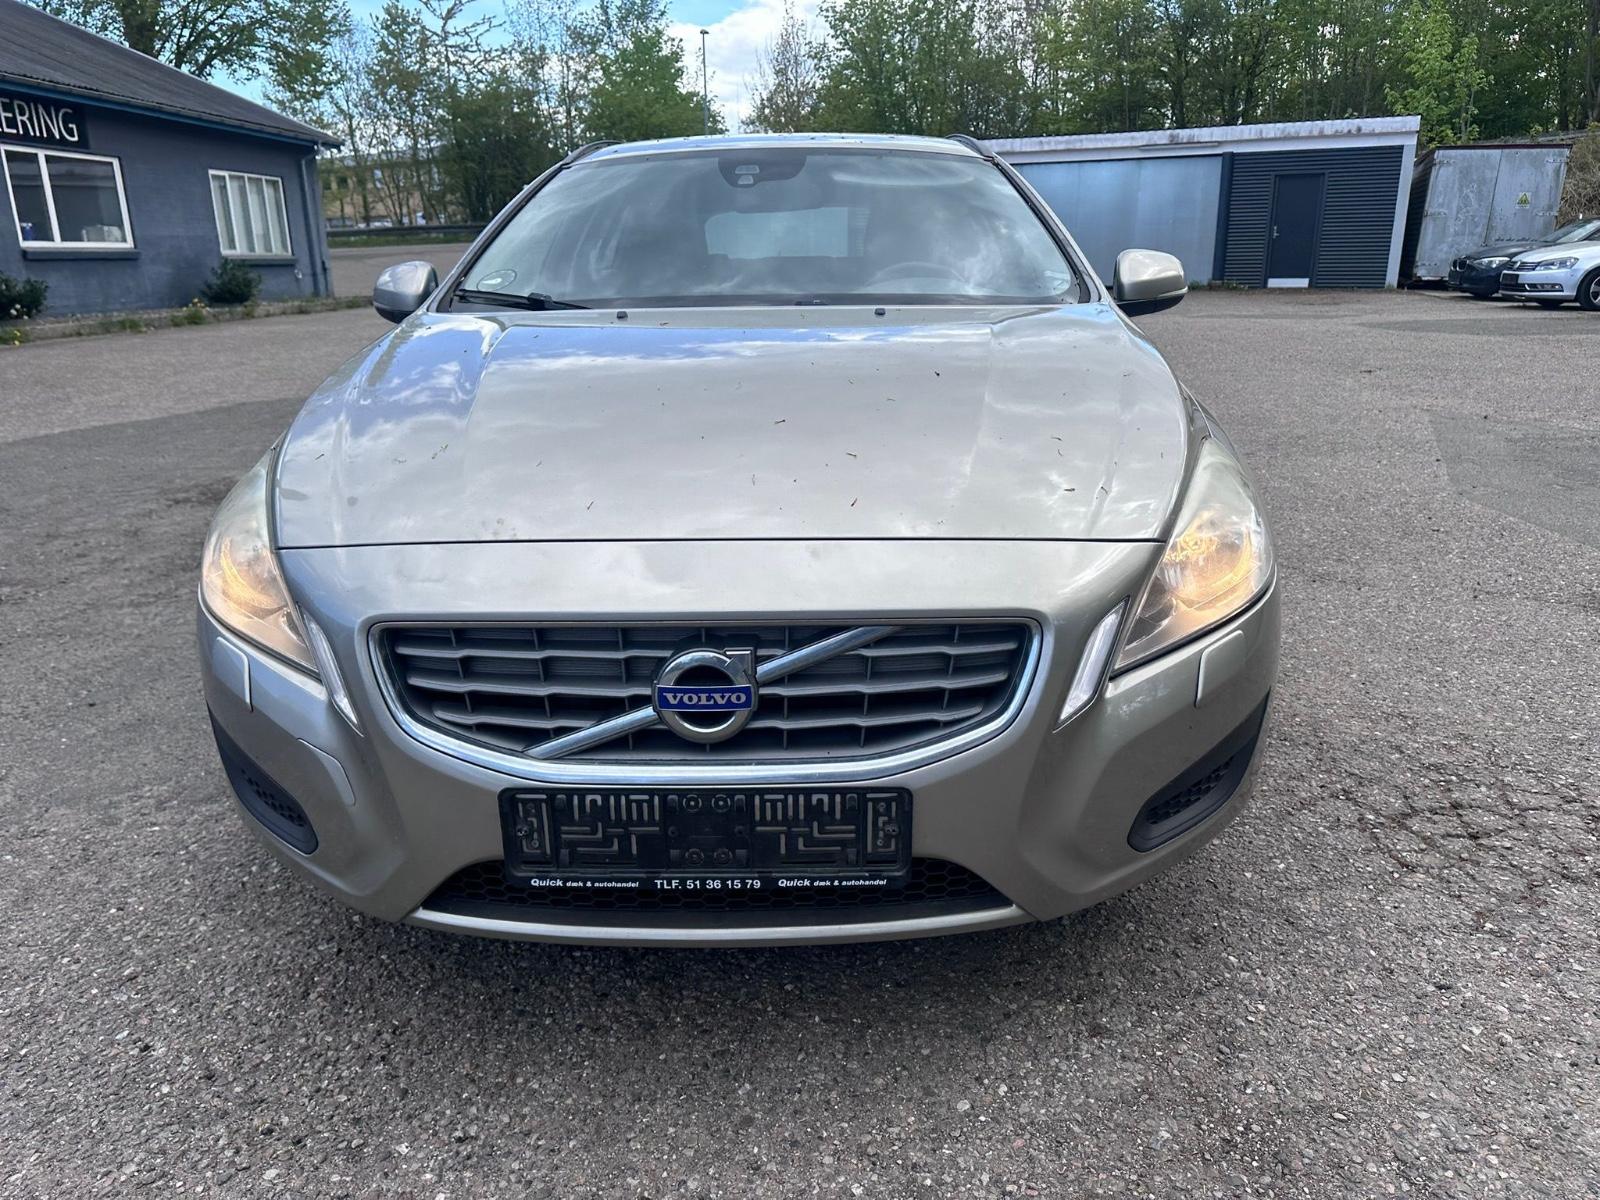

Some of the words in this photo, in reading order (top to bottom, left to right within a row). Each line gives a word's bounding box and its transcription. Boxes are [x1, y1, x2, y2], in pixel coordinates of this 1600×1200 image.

[0, 97, 79, 142] ERING
[662, 692, 747, 705] VOLVO
[530, 878, 564, 887] Quick
[594, 880, 640, 888] autohandel
[654, 879, 682, 889] TLF.
[686, 879, 701, 889] 51
[705, 879, 722, 889] 36
[726, 879, 742, 889] 15
[745, 879, 761, 889] 79
[778, 878, 811, 887] Quick
